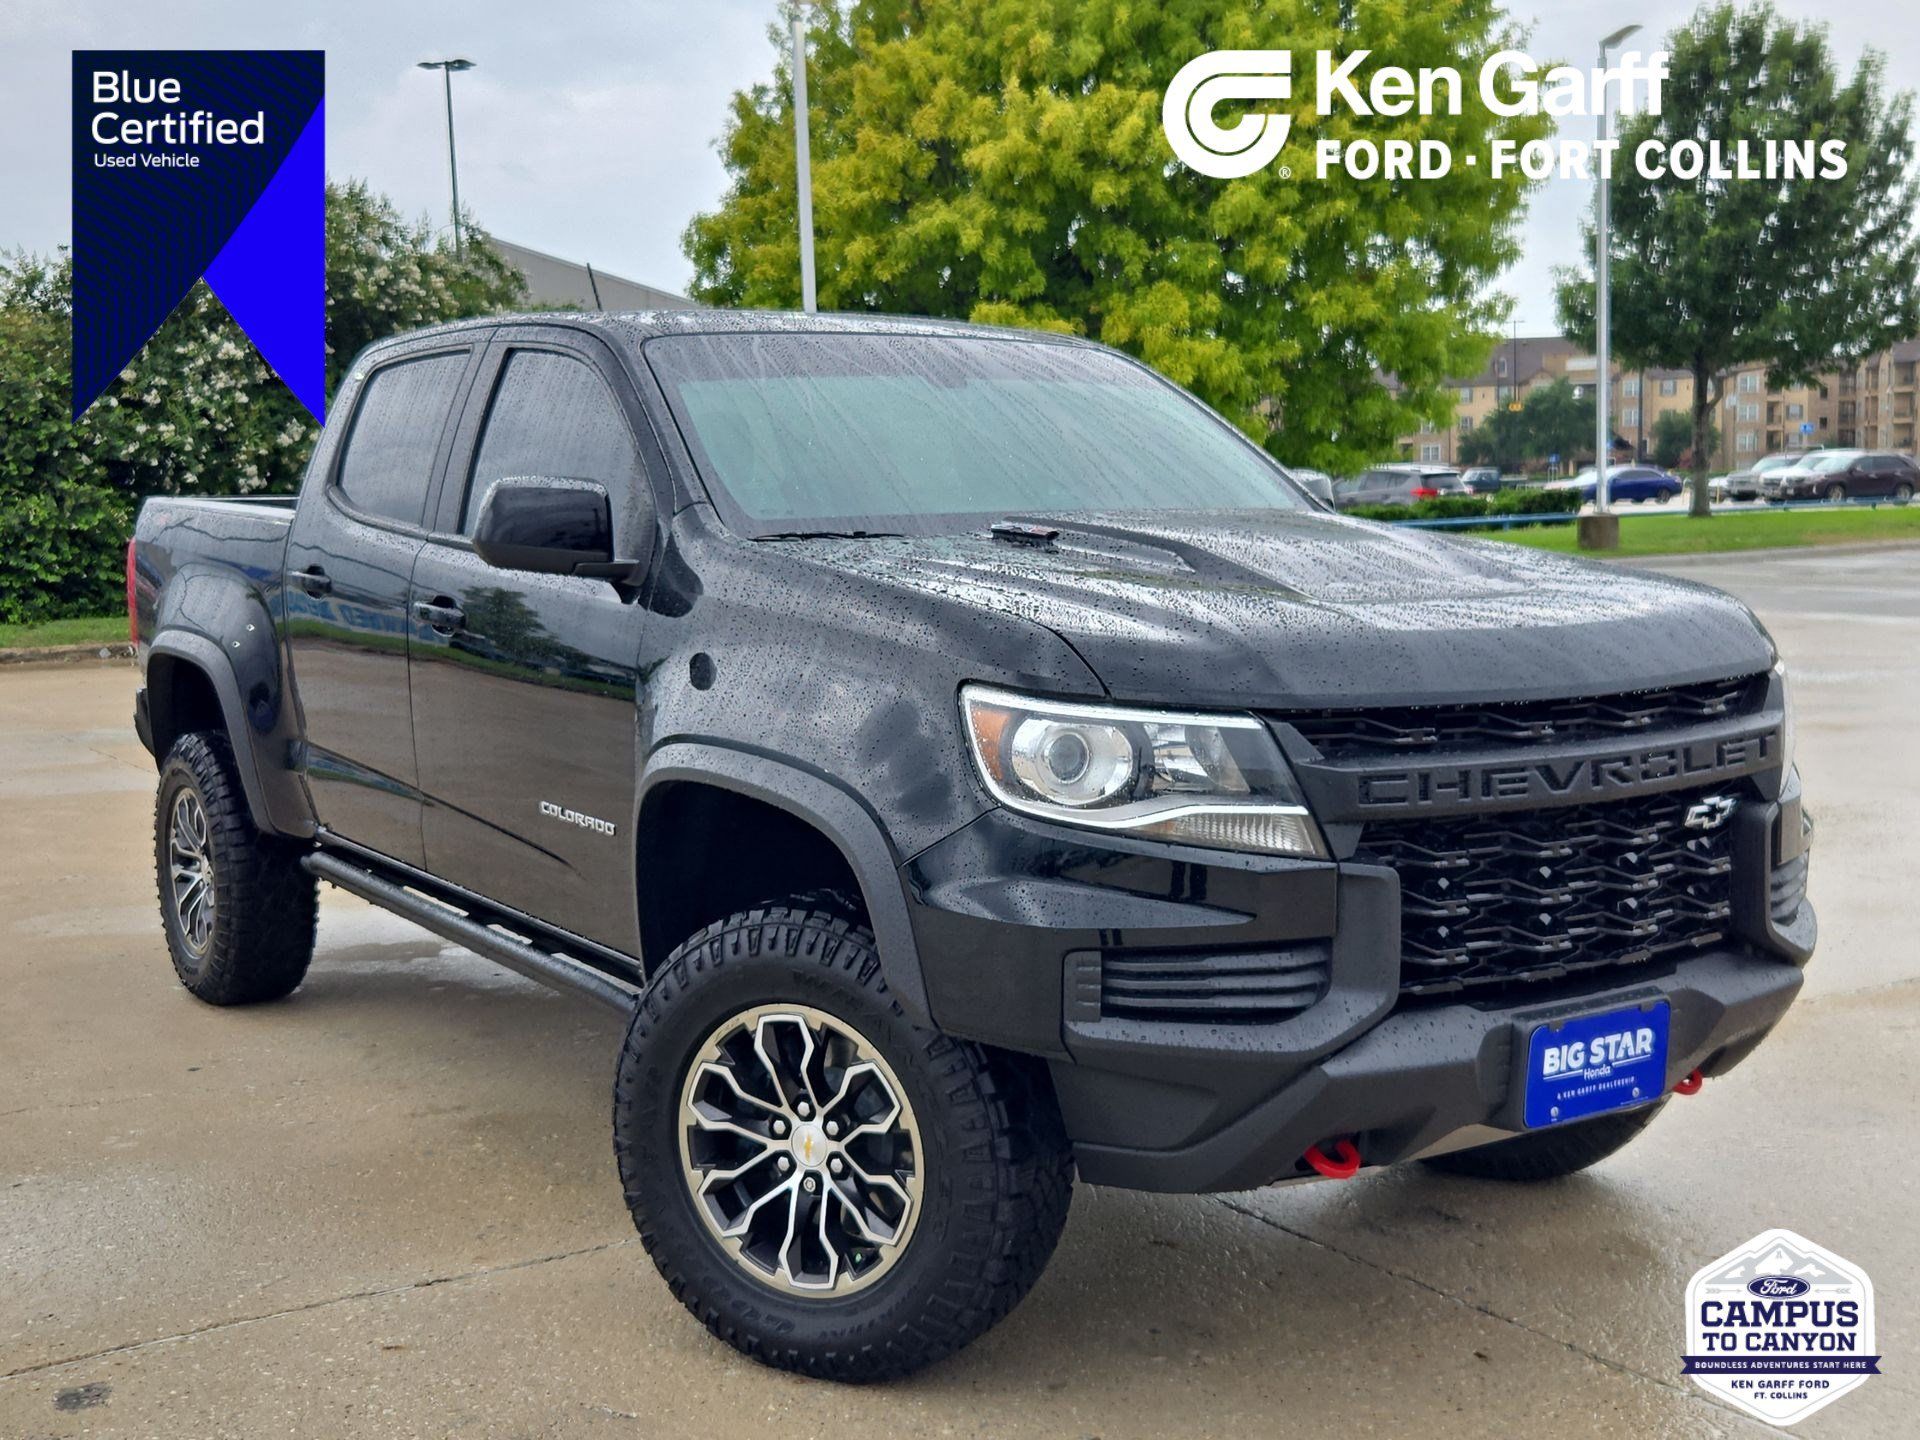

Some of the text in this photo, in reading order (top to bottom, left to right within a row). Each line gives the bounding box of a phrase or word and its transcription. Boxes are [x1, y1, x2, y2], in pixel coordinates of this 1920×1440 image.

[1357, 733, 1778, 807] CHEVROLET
[540, 800, 615, 836] COLORADO
[1543, 1027, 1654, 1076] BIG STAR
[1583, 1064, 1611, 1080] Honda
